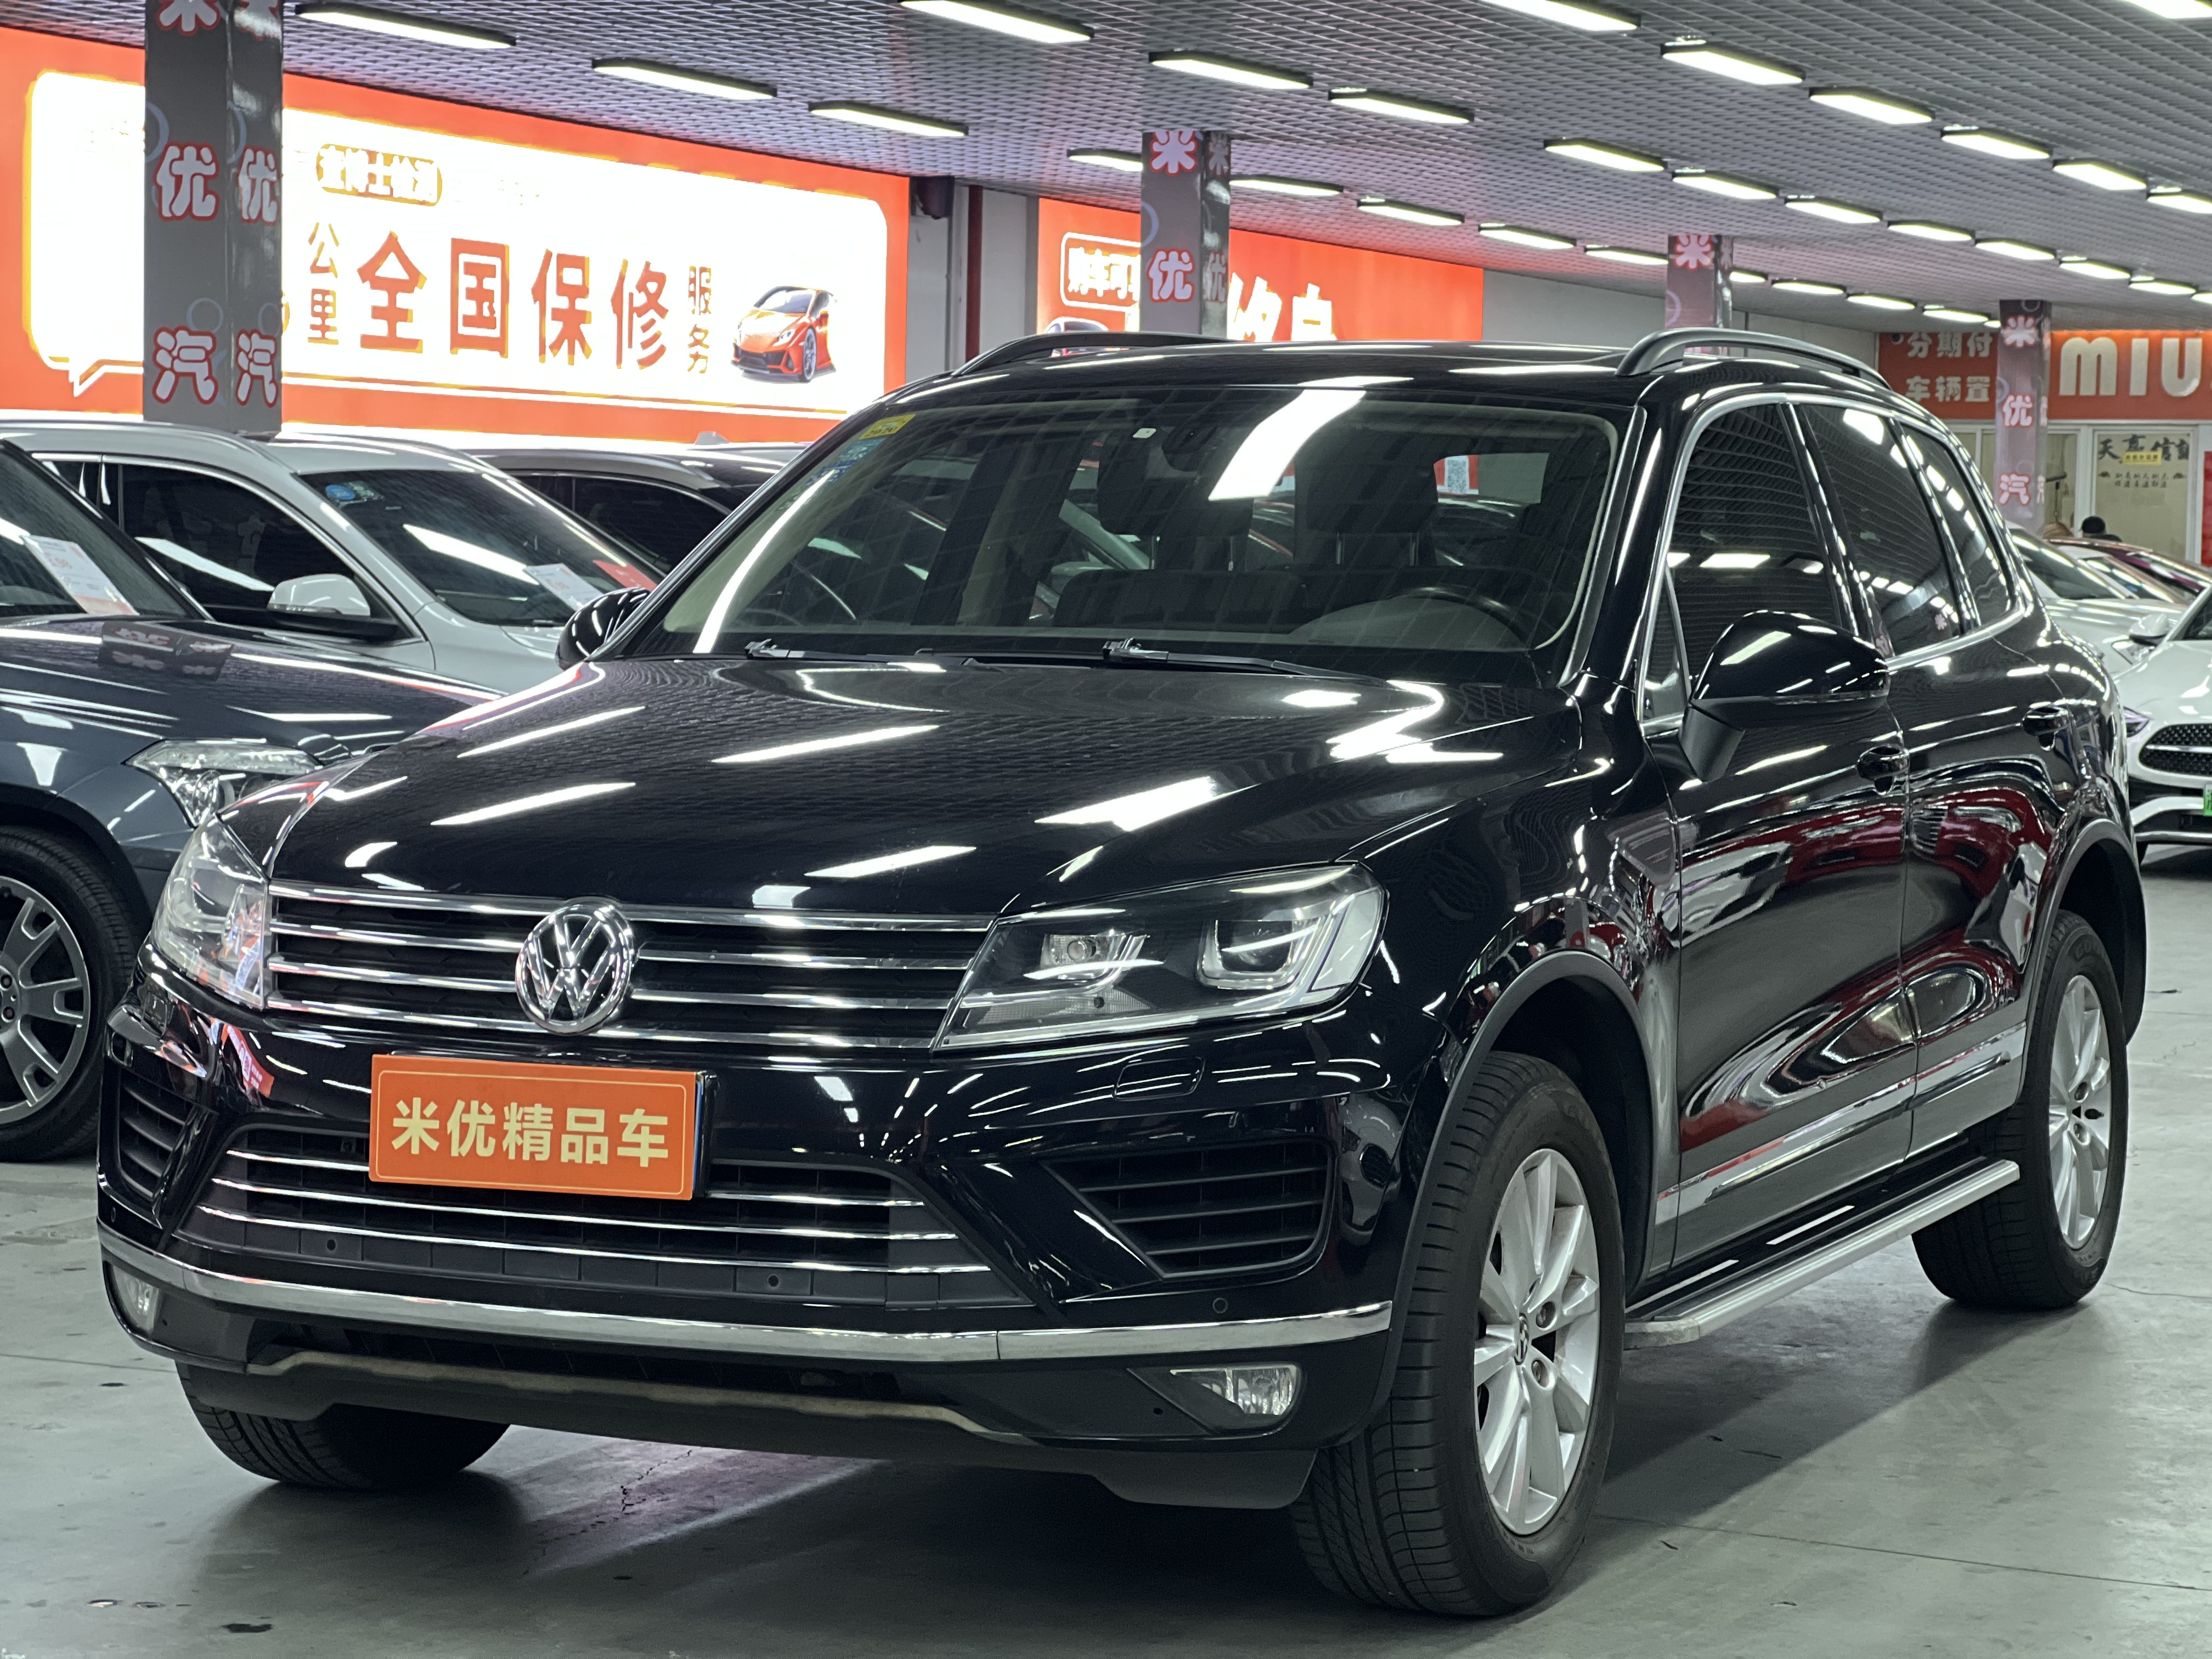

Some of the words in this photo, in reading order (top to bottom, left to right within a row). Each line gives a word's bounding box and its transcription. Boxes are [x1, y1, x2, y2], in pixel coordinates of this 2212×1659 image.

[1675, 234, 1713, 270] 米
[357, 230, 669, 370] 全国保修
[687, 265, 712, 374] 服务
[1905, 375, 1991, 402] 车辆置
[2000, 315, 2035, 505] 米优汽
[391, 1097, 669, 1167] 米优精品车
